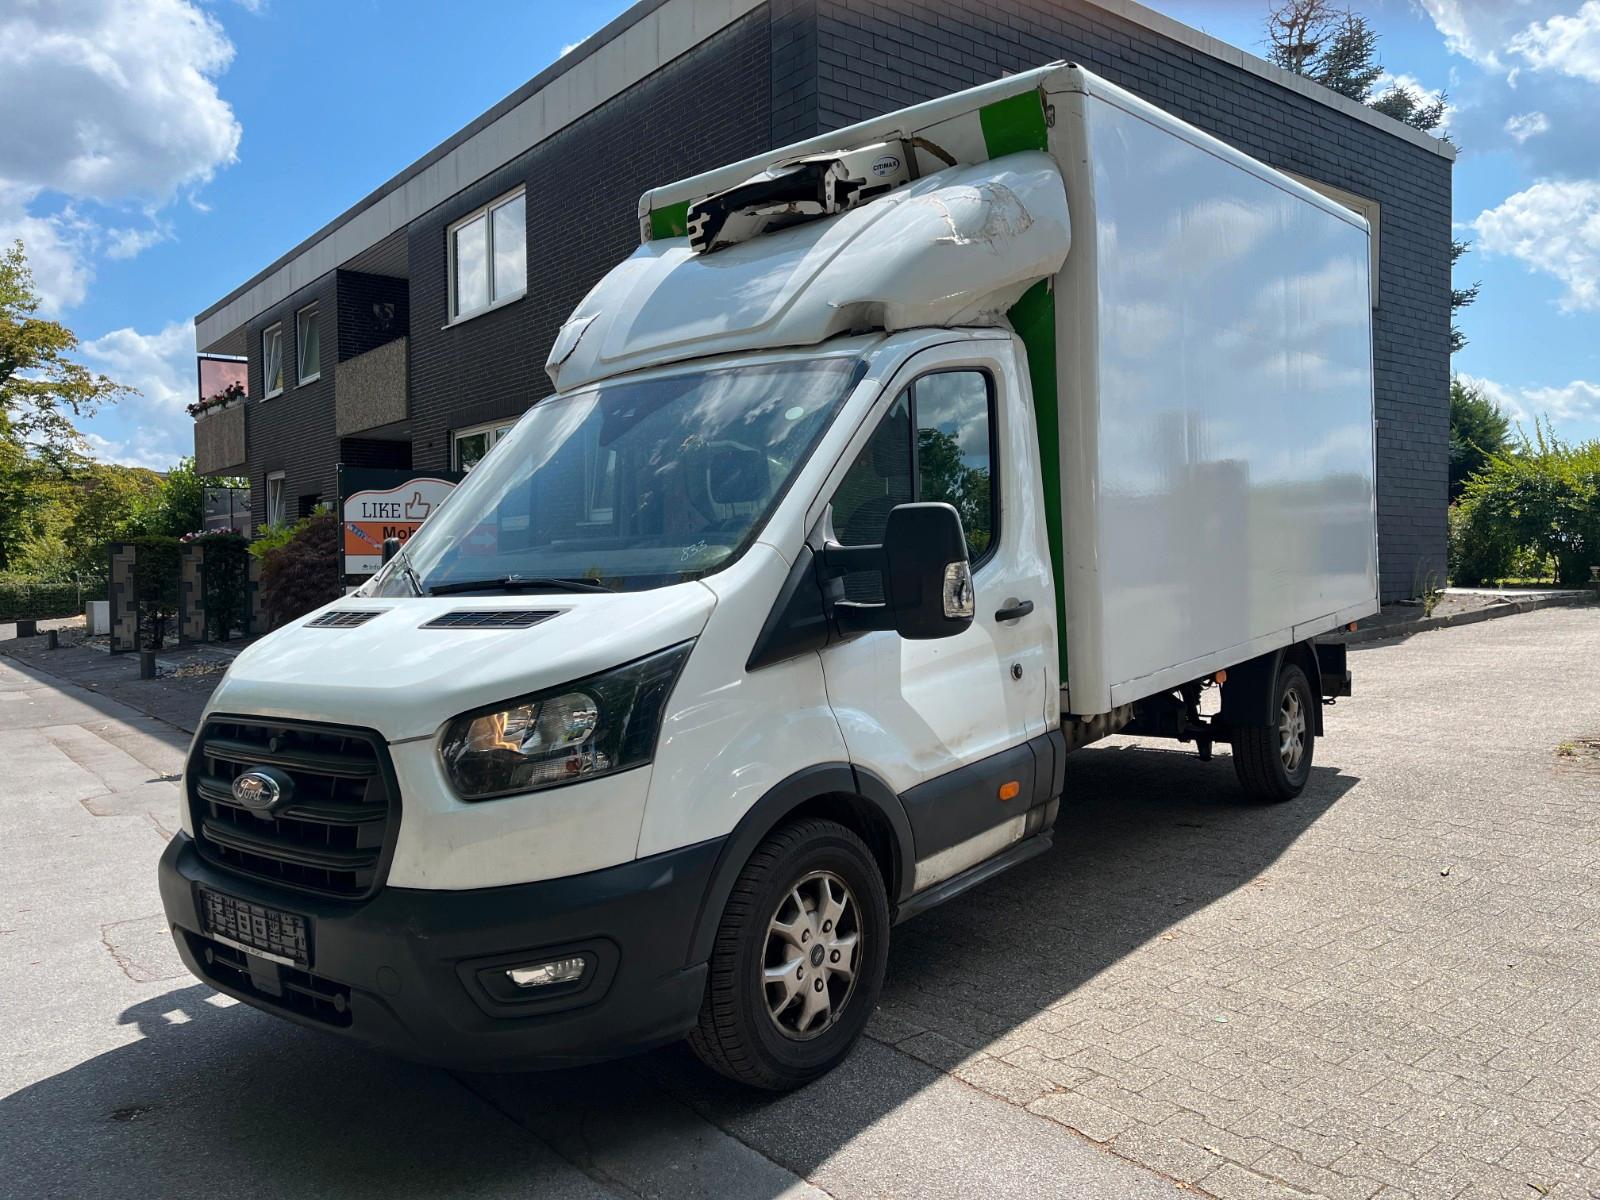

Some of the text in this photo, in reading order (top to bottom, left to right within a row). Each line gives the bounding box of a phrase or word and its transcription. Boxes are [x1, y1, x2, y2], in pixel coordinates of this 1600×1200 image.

[872, 160, 897, 171] CITIMAX
[361, 502, 401, 519] LIKE
[237, 778, 267, 801] Ford
